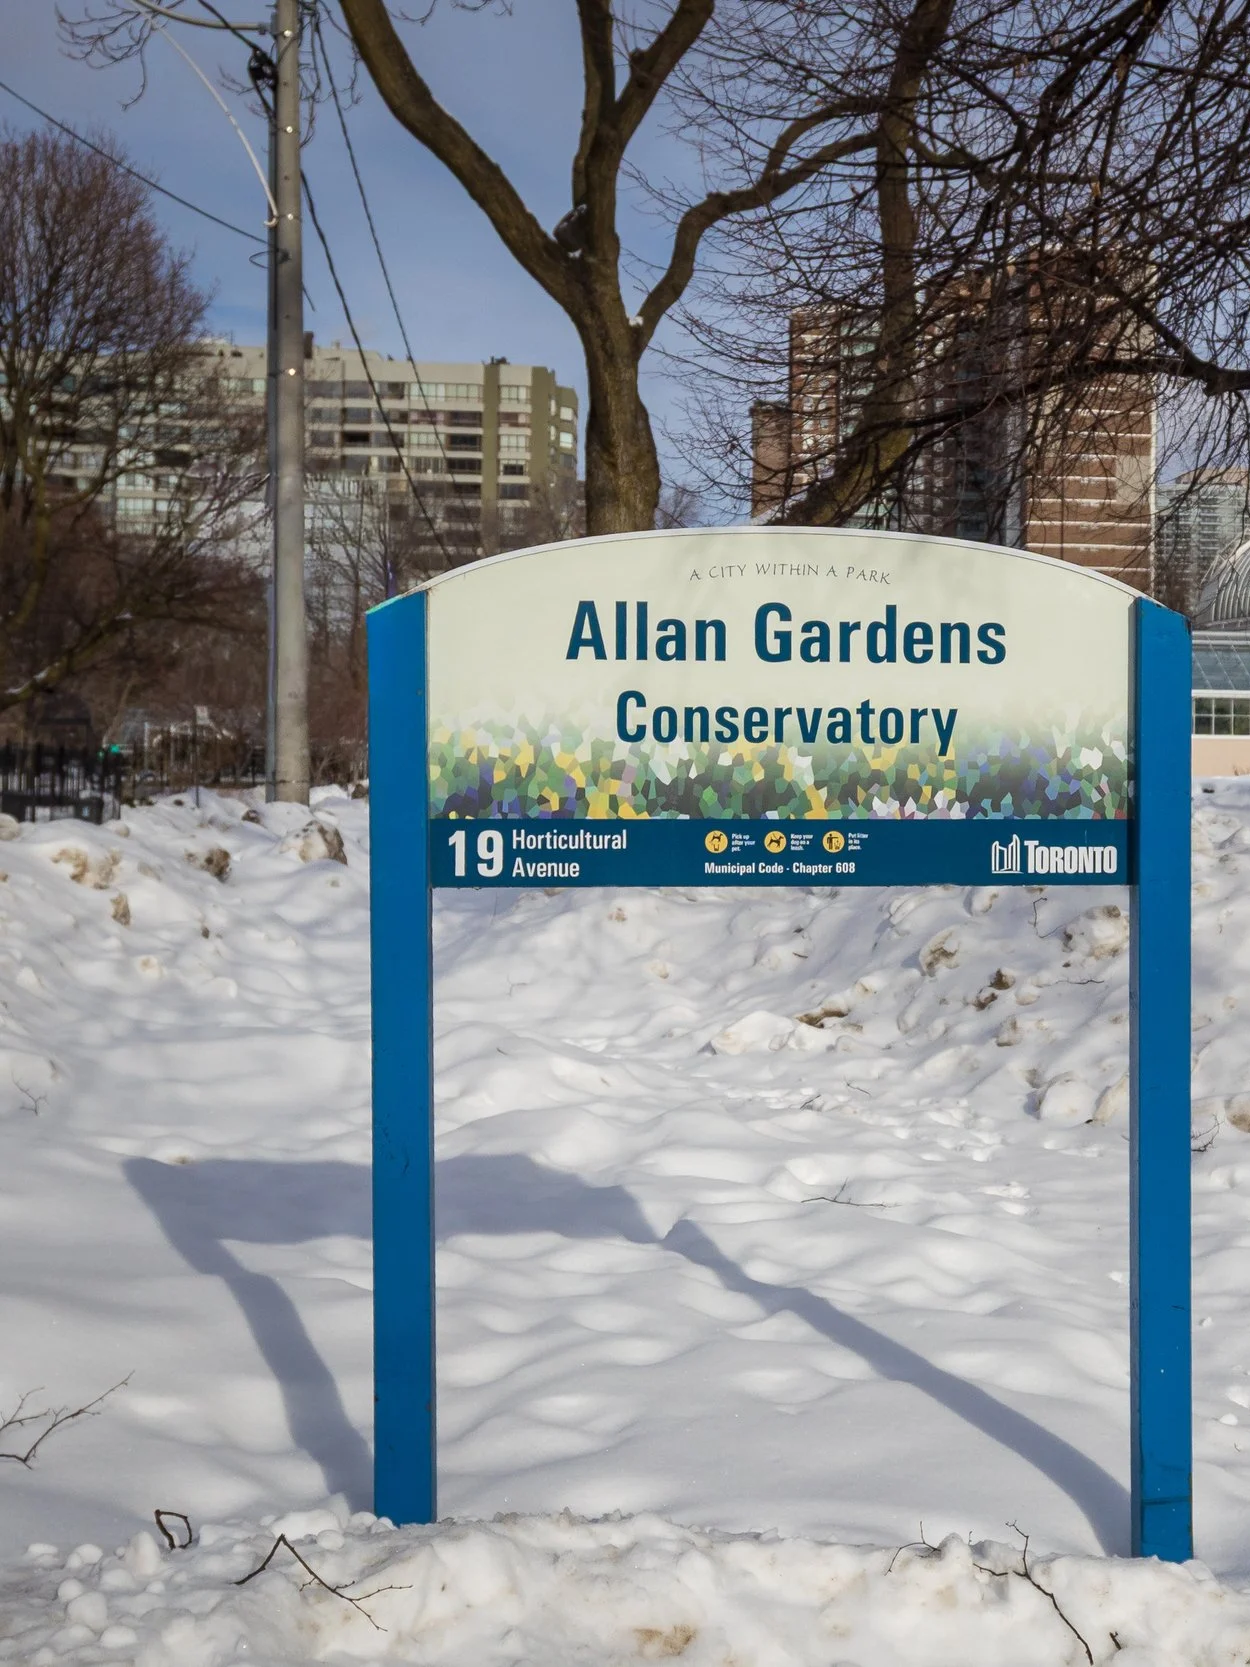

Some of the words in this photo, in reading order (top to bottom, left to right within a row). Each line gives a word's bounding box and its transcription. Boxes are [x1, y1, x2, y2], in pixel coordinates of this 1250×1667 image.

[689, 569, 701, 581] A
[708, 564, 747, 579] CITY
[755, 563, 819, 576] WITHIN
[826, 565, 838, 578] A
[846, 566, 890, 585] PARK
[565, 600, 727, 662] Allan
[754, 602, 1007, 665] Gardens
[615, 690, 959, 757] Conservatory
[448, 829, 504, 878] 19
[512, 829, 627, 850] Horticultural
[512, 857, 580, 878] Avenue
[704, 862, 756, 876] Municipal
[758, 862, 784, 874] Code
[792, 862, 833, 876] Chapter
[835, 862, 856, 874] 608
[1024, 840, 1118, 875] TORONTO
